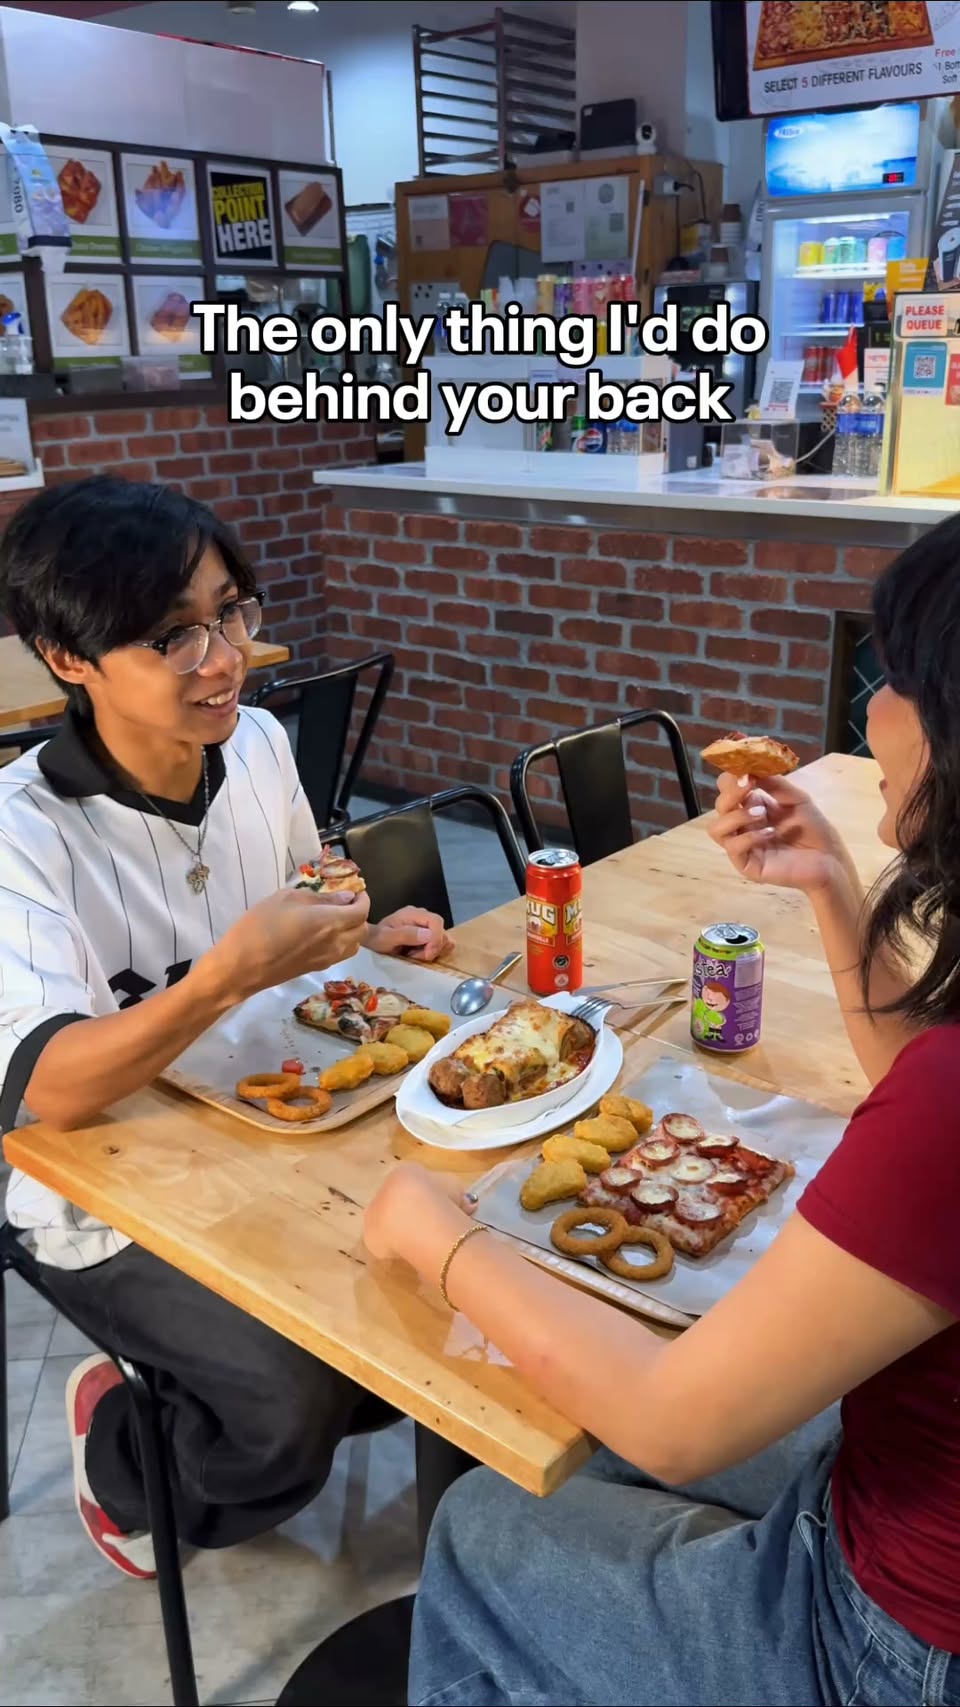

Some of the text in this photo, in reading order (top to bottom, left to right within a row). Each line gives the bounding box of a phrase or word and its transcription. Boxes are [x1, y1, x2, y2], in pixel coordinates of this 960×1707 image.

[934, 48, 956, 57] Free
[764, 62, 922, 94] SELECT 5 DIFFERENT FLAVOURS
[942, 74, 958, 84] Soft
[213, 195, 266, 226] POINT
[217, 218, 272, 253] HERE
[905, 305, 945, 317] PLEASE
[906, 319, 943, 331] QUEUE
